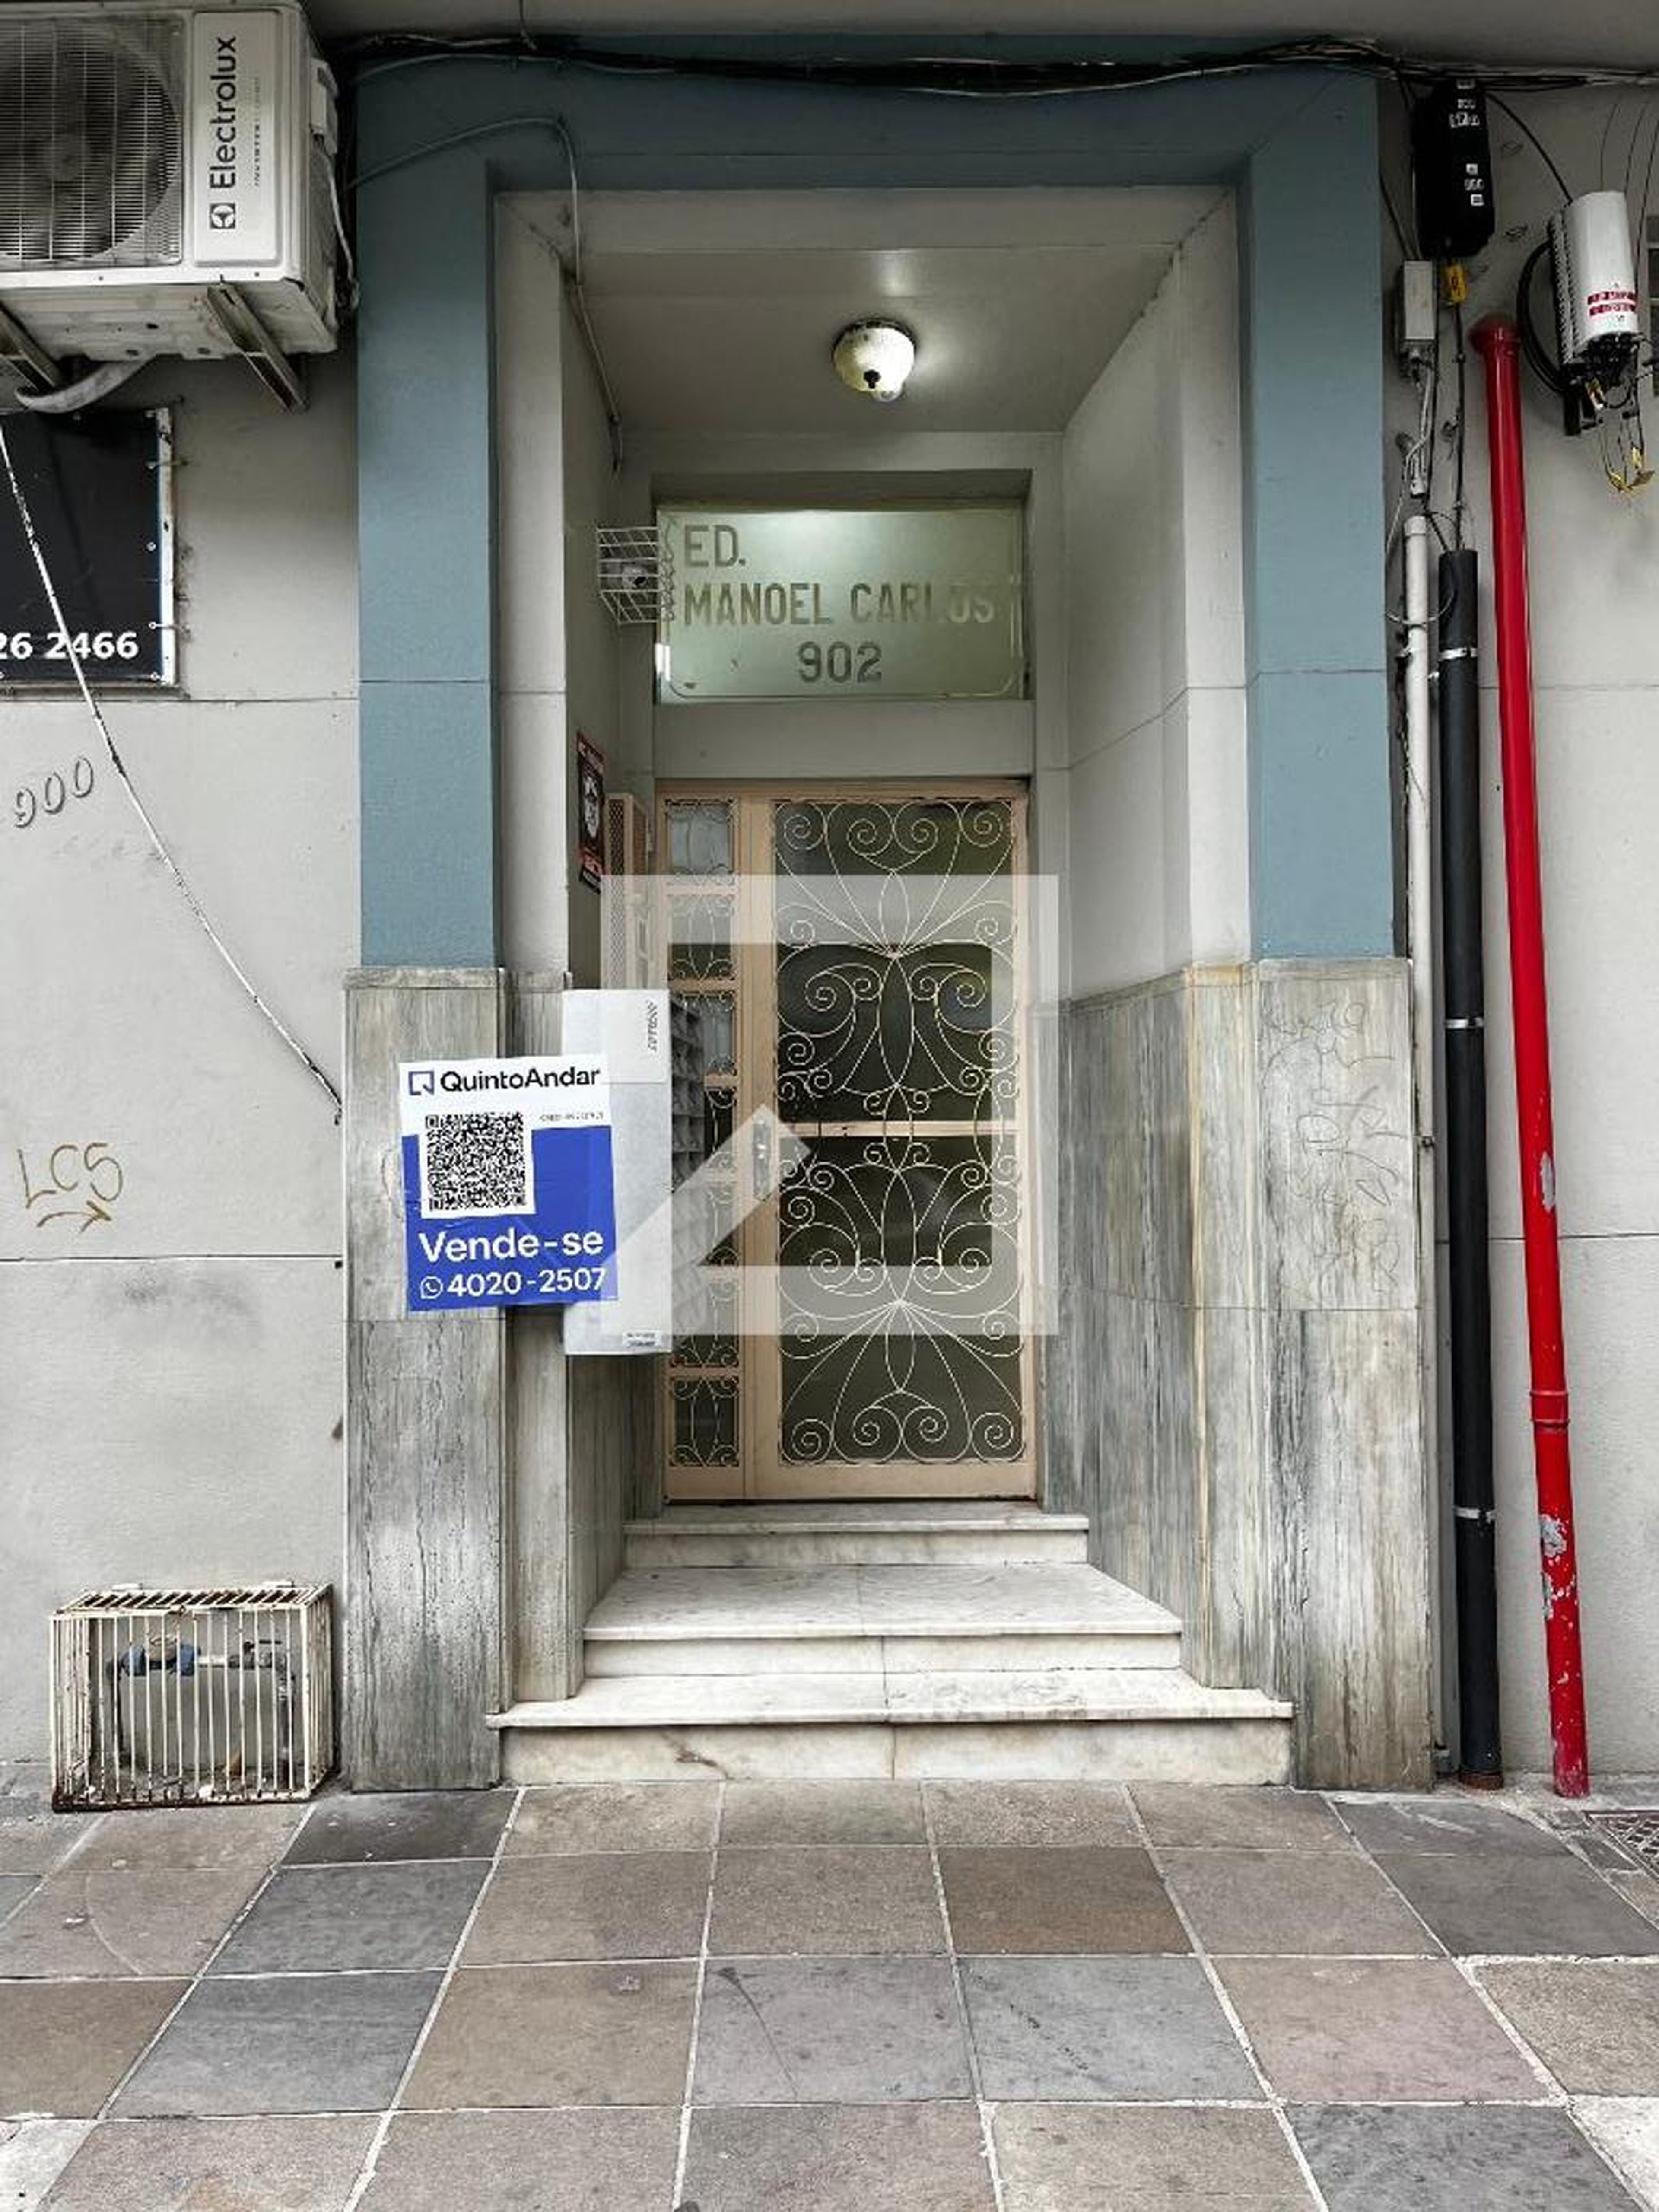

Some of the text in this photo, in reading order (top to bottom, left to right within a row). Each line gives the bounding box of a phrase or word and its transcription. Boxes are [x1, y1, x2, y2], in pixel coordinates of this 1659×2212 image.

[210, 36, 236, 189] Electrolux
[684, 525, 746, 567] ED.
[684, 583, 832, 625] MANOEL
[45, 631, 139, 659] 2466
[798, 642, 882, 683] 902
[13, 757, 95, 828] 900
[440, 1067, 601, 1093] QuintoAndar
[419, 1227, 604, 1263] Vende-se
[448, 1267, 606, 1297] 4020-2507
